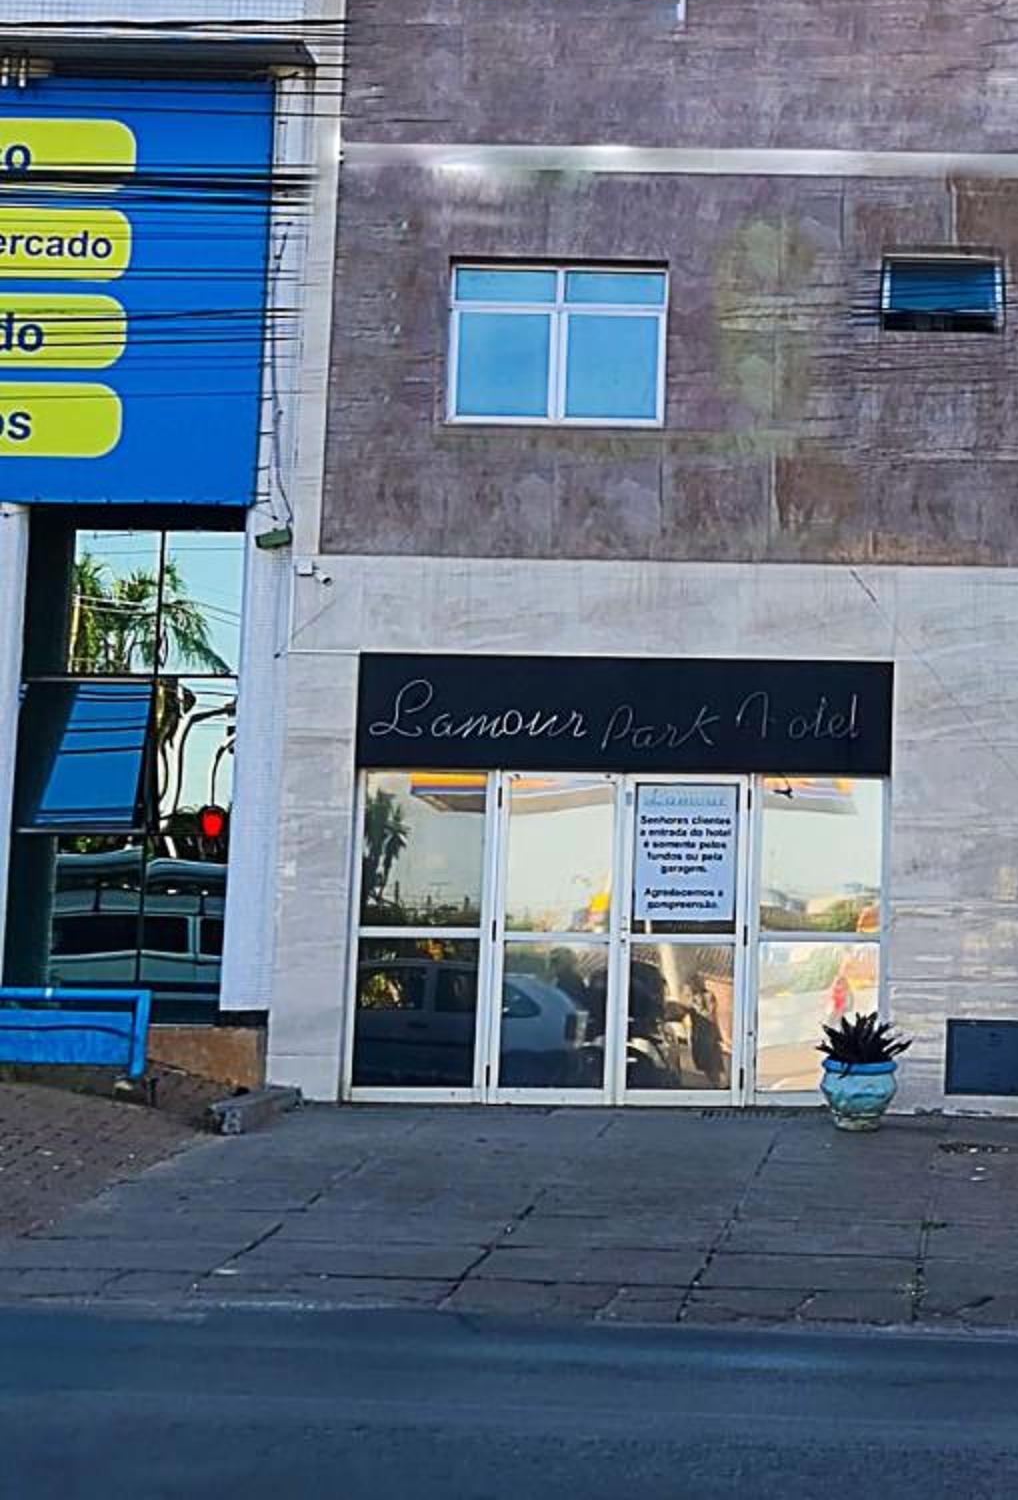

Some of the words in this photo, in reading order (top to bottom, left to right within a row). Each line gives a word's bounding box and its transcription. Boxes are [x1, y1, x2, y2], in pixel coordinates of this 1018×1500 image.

[369, 678, 588, 739] Lamour
[601, 705, 720, 751] Park
[648, 828, 687, 837] entrada
[690, 828, 703, 837] do
[705, 828, 732, 837] hotel
